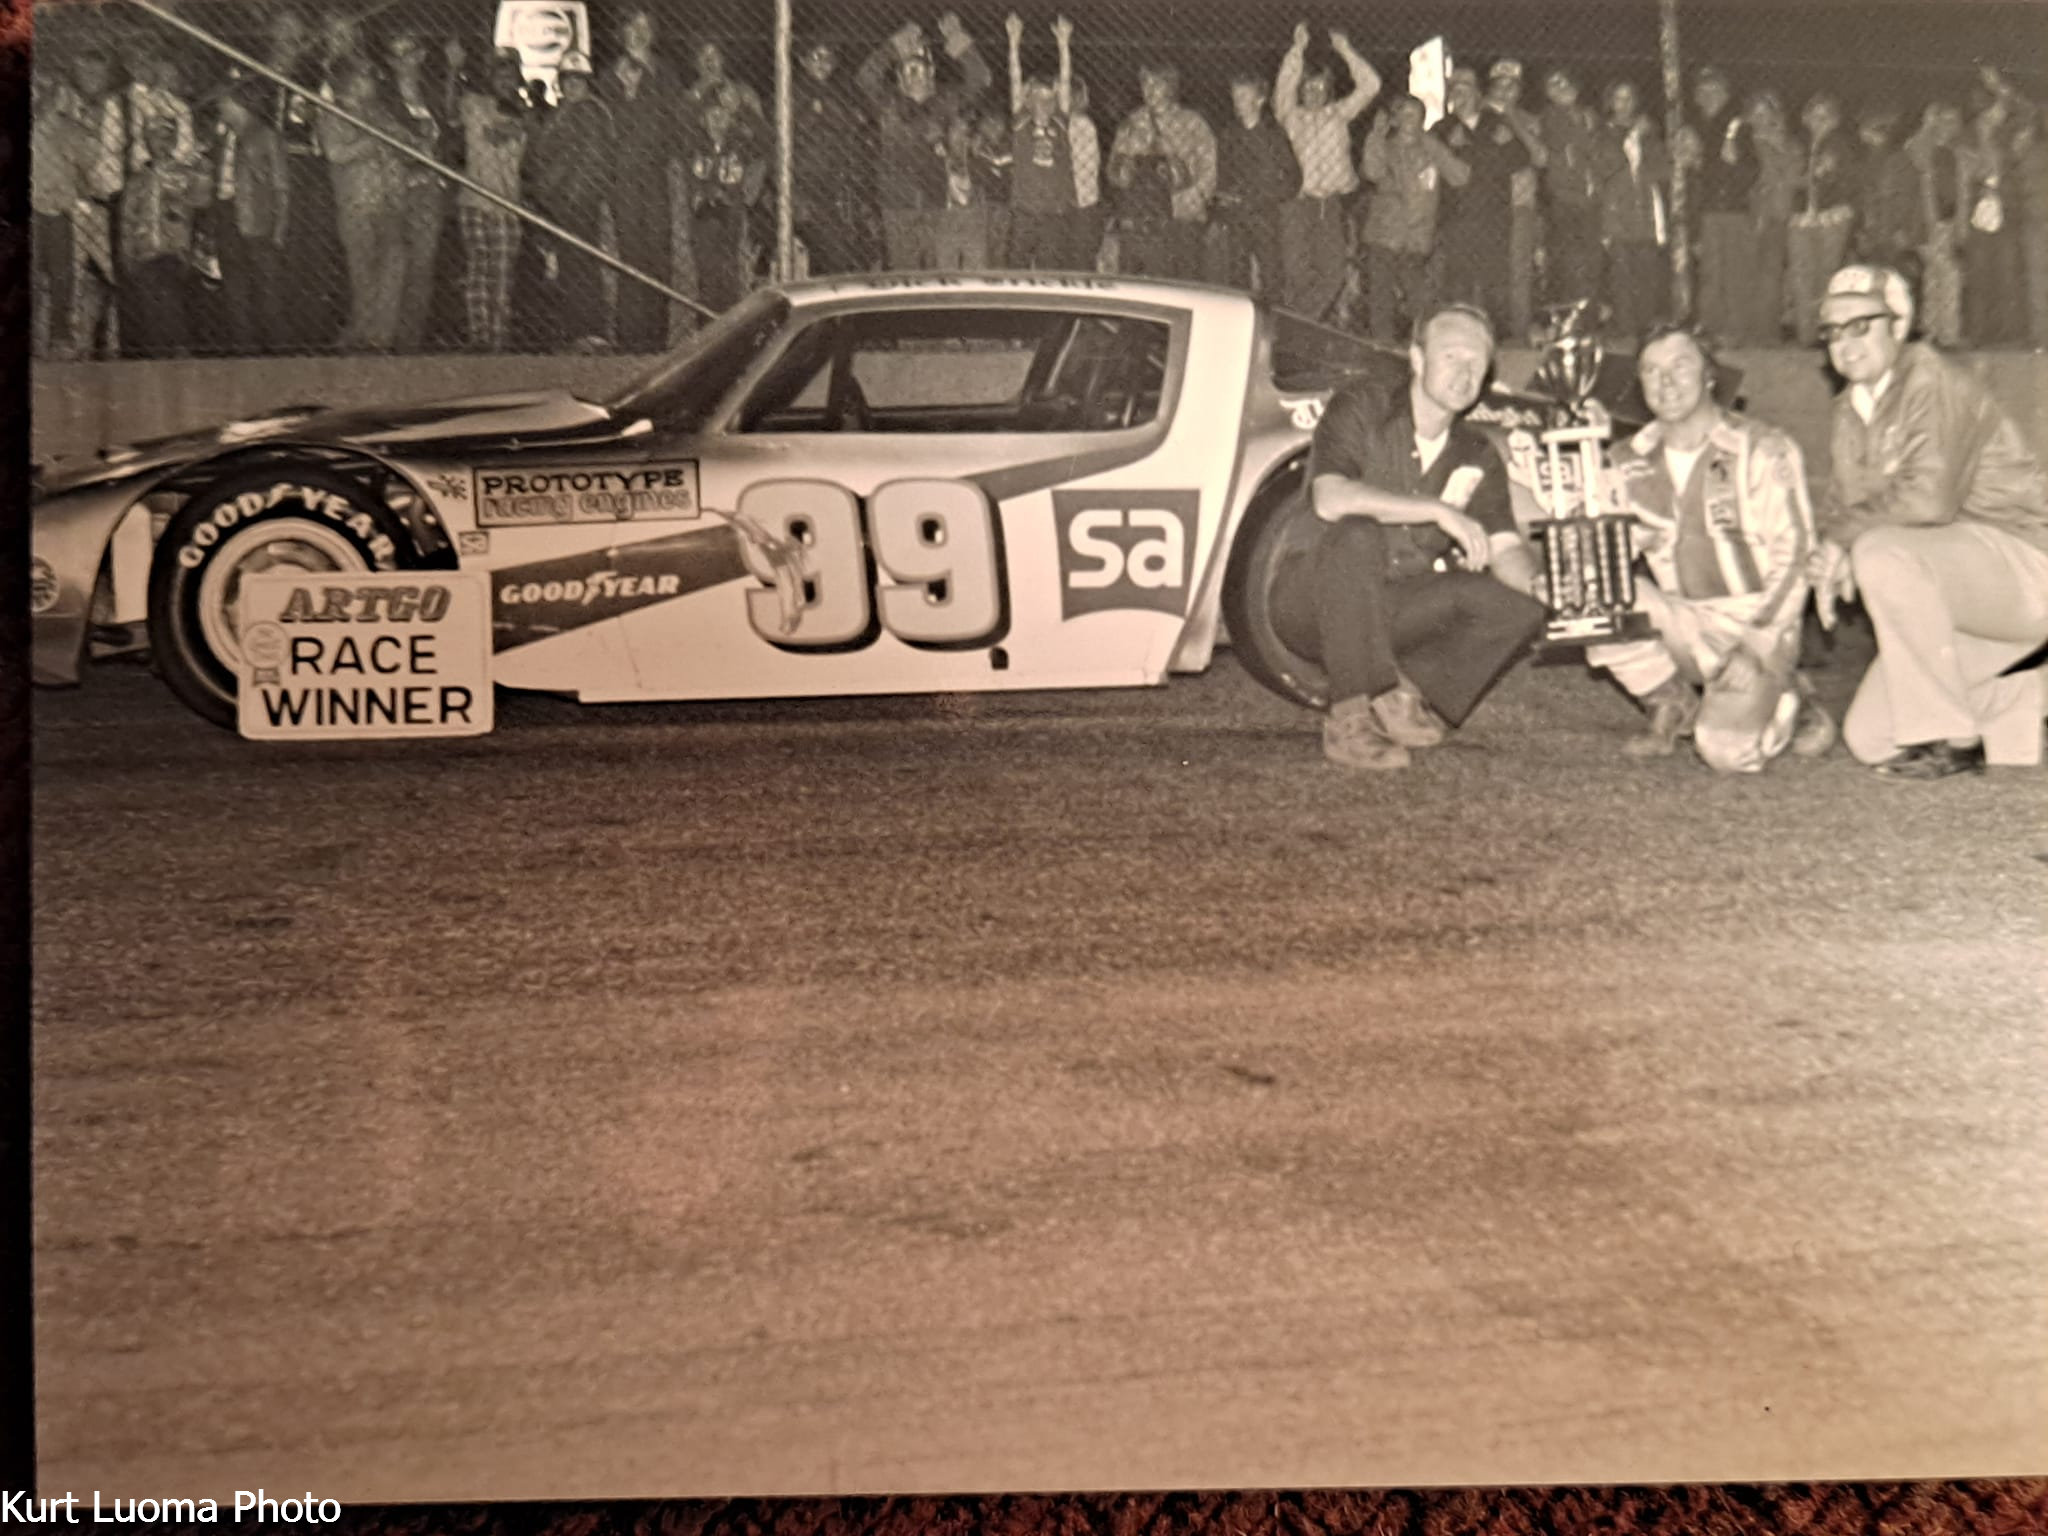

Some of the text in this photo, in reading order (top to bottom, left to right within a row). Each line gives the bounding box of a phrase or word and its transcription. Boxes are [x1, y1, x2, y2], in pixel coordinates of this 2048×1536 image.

[481, 469, 685, 496] PROTOTYPE
[736, 477, 1012, 654] 99
[278, 585, 452, 624] ARTGO
[500, 571, 680, 606] GOODYEAR
[291, 635, 438, 675] RACE
[262, 686, 473, 727] WINNER
